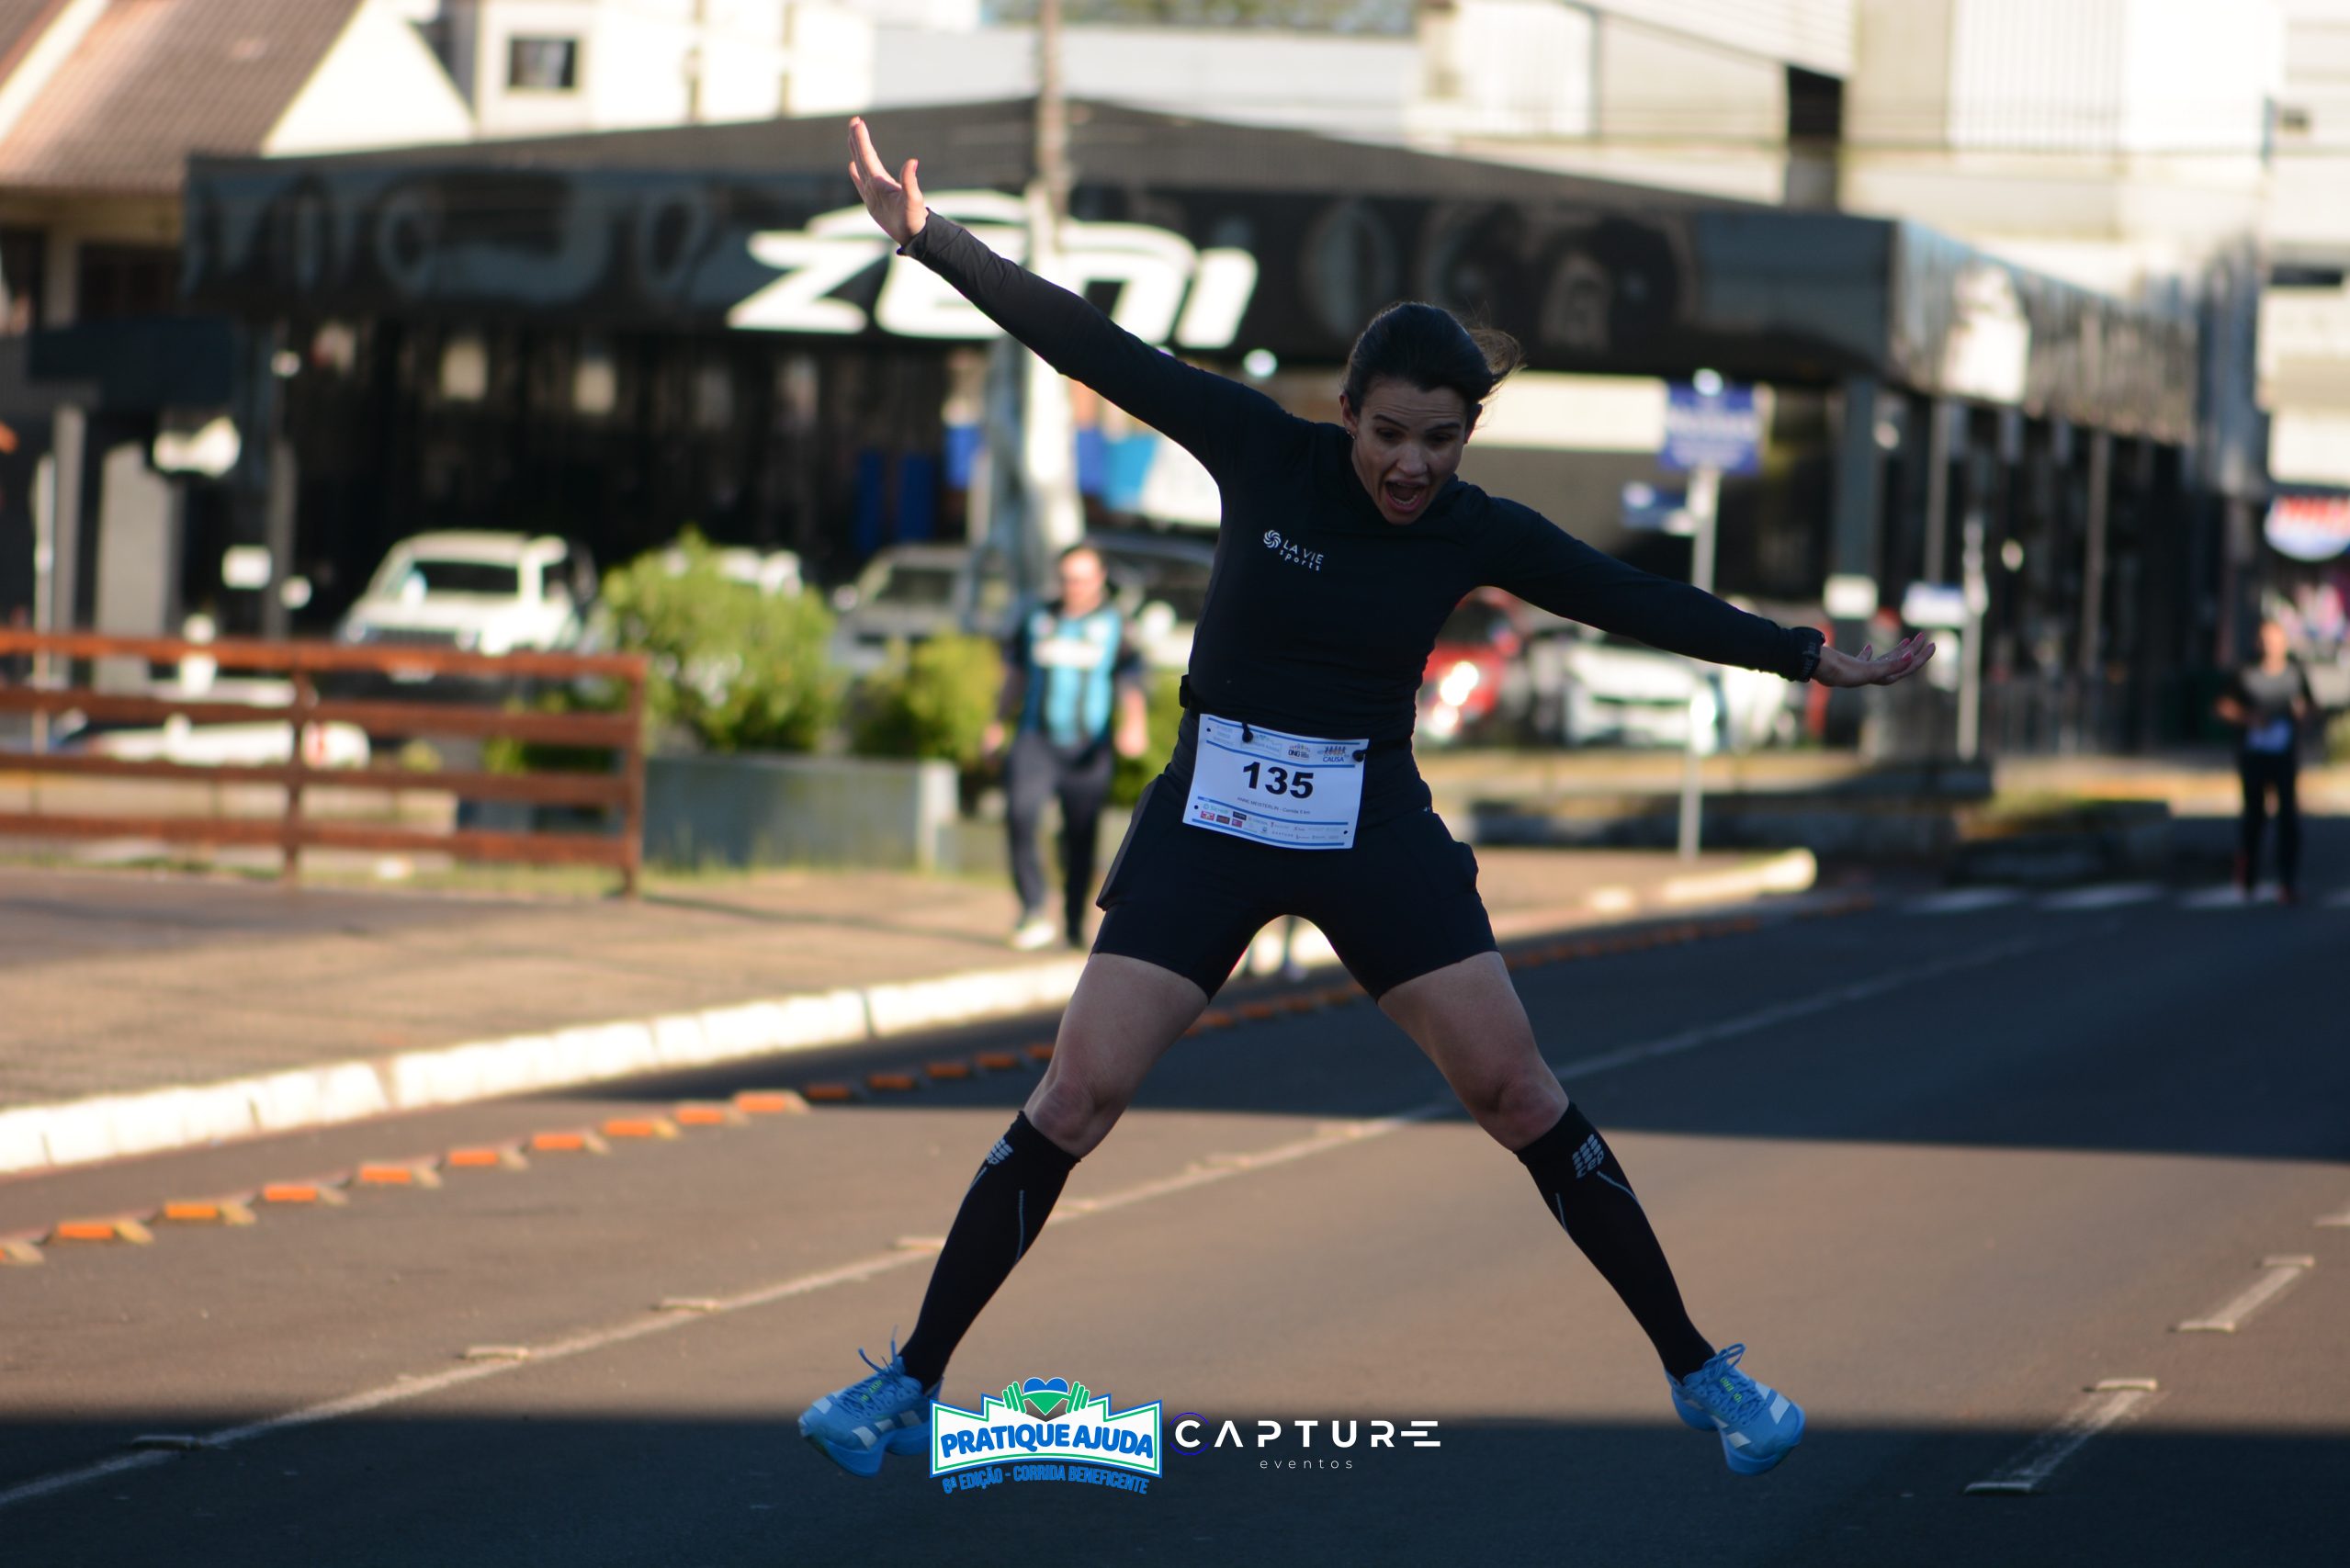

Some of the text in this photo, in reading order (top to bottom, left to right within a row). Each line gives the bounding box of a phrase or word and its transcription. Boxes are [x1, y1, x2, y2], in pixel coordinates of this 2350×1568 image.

[1279, 549, 1320, 571] sports
[1282, 539, 1324, 565] LA VIE
[1243, 761, 1314, 799] 135
[1237, 796, 1250, 805] ANNE
